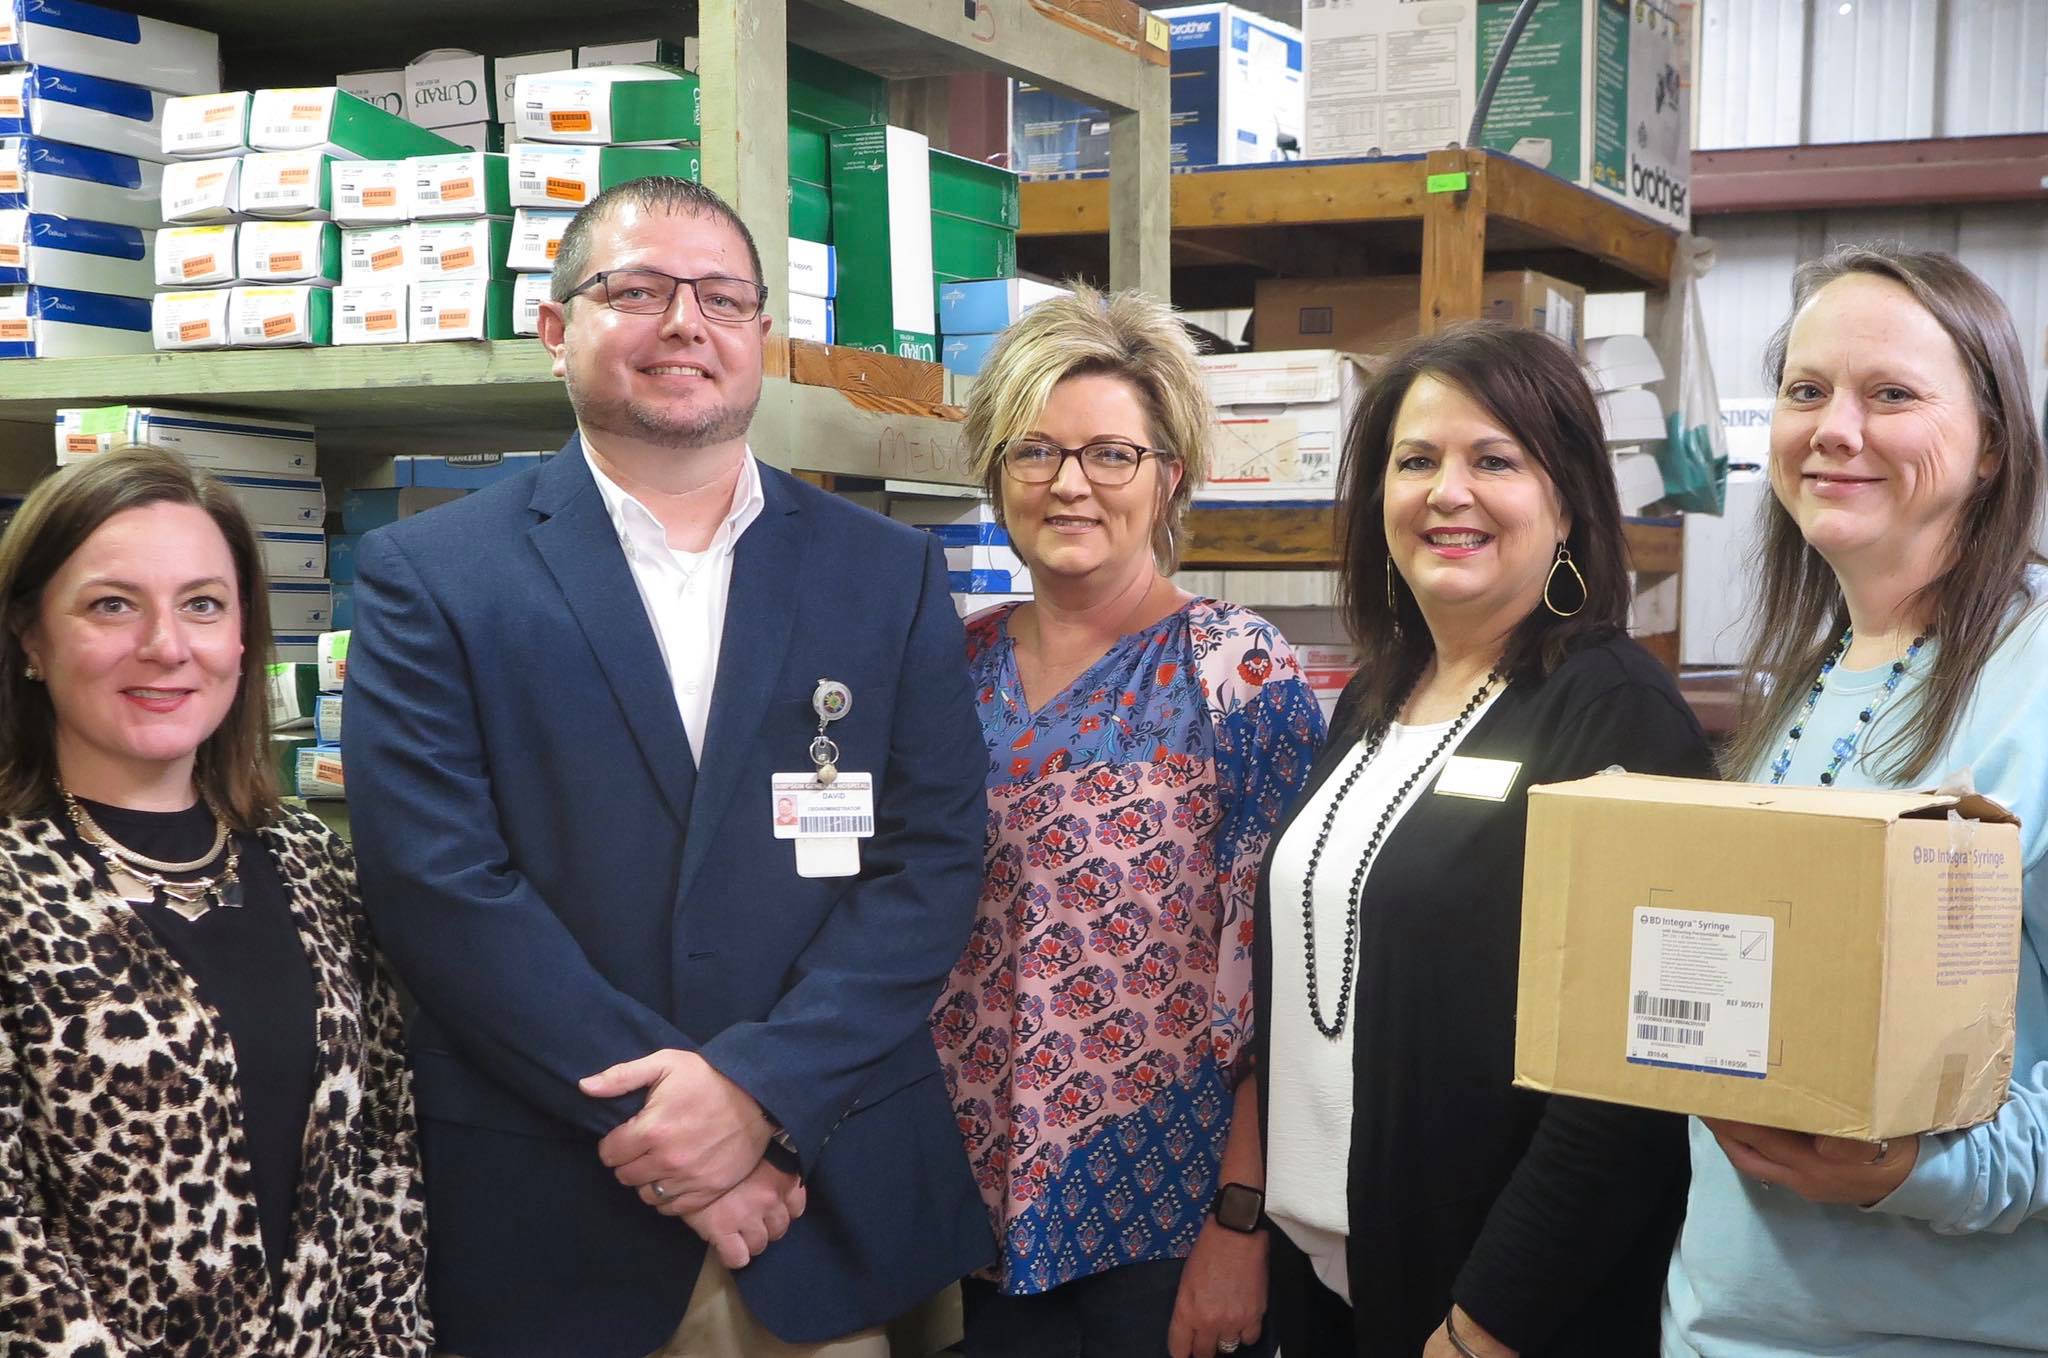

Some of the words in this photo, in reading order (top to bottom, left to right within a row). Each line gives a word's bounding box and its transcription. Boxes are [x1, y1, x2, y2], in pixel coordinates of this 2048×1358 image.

[415, 80, 477, 106] CURAD
[1631, 153, 1687, 218] brother
[1719, 410, 1772, 426] SIMPS
[822, 792, 846, 800] DAVID
[1923, 848, 1935, 863] BD
[1973, 850, 2006, 869] Syringe
[1649, 916, 1662, 925] BD
[1698, 920, 1730, 932] Syringe
